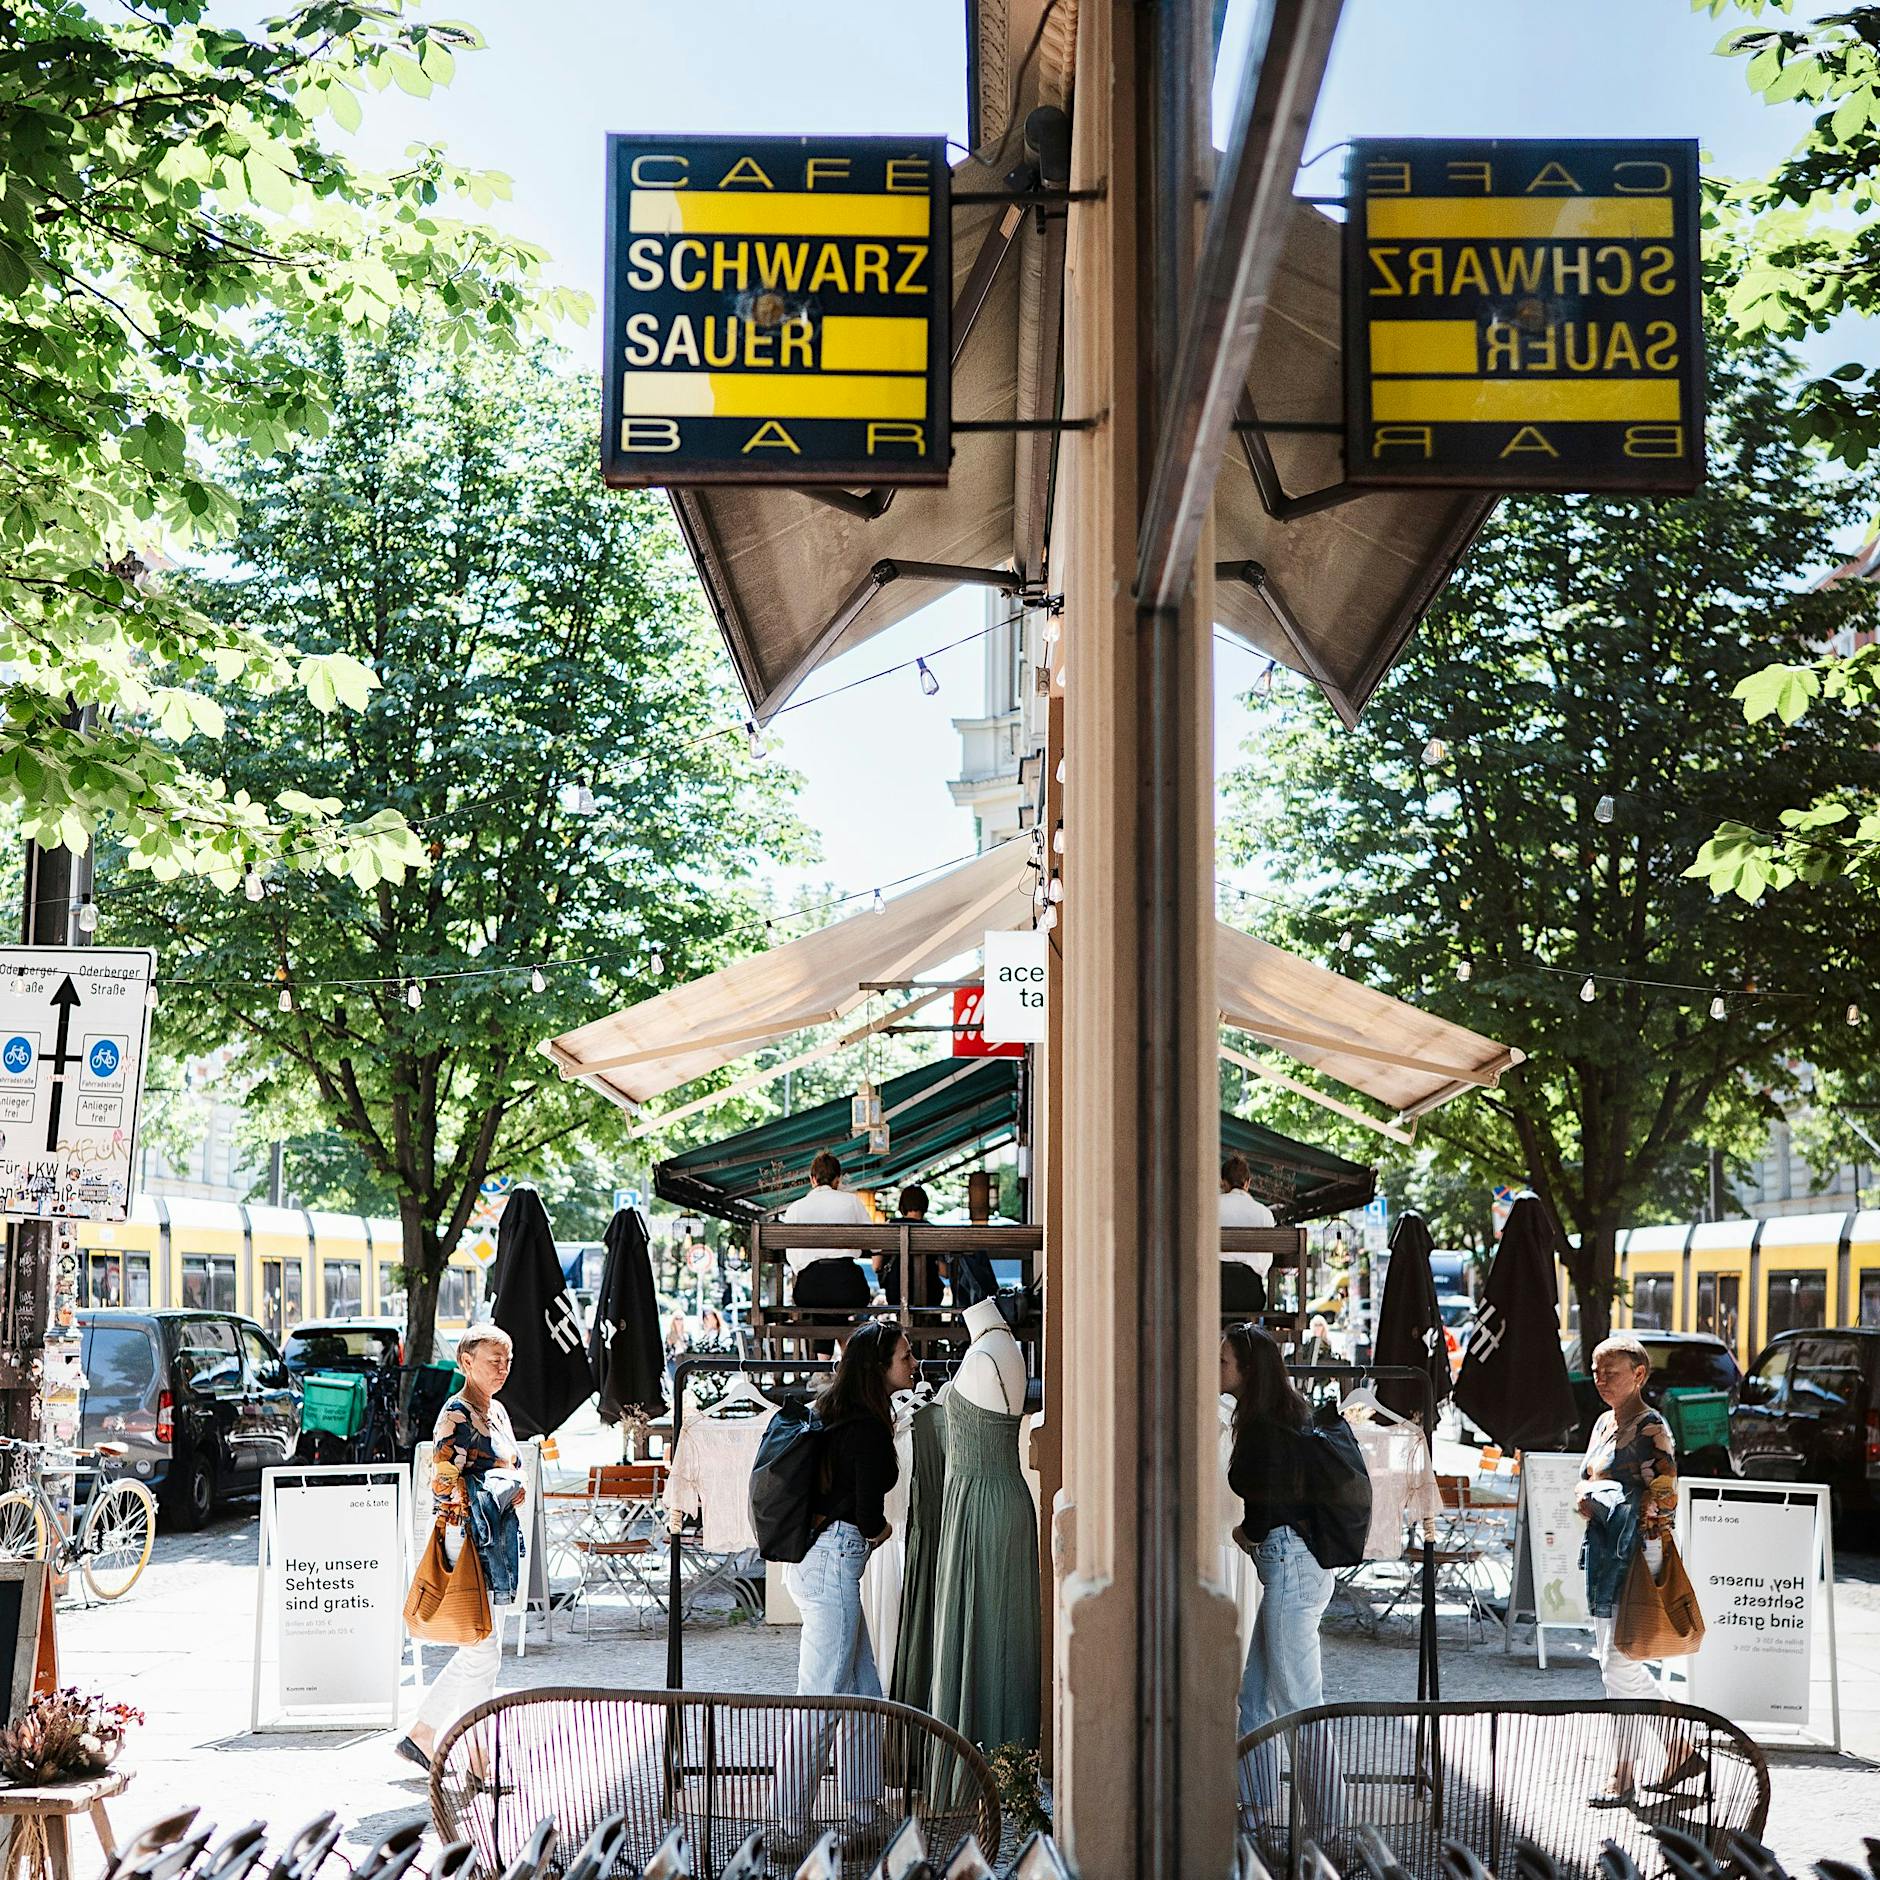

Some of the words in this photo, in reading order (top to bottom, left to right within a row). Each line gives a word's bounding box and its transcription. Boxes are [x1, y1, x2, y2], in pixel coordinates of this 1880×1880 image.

[631, 154, 930, 192] CAFÉ
[627, 239, 929, 294] SCHWARZ
[624, 313, 814, 368] SAUER
[620, 418, 926, 456] BAR
[79, 965, 141, 981] Oderberger
[999, 967, 1044, 982] ace
[90, 983, 126, 996] Straße
[4, 1108, 19, 1119] frei
[82, 1100, 118, 1113] Anlieger
[92, 1112, 106, 1123] frei
[27, 1161, 59, 1178] LKW
[286, 1558, 319, 1575] Hey,
[325, 1559, 379, 1571] unsere
[286, 1577, 354, 1591] Sehtests
[286, 1595, 318, 1610] sind
[324, 1595, 375, 1613] gratis.
